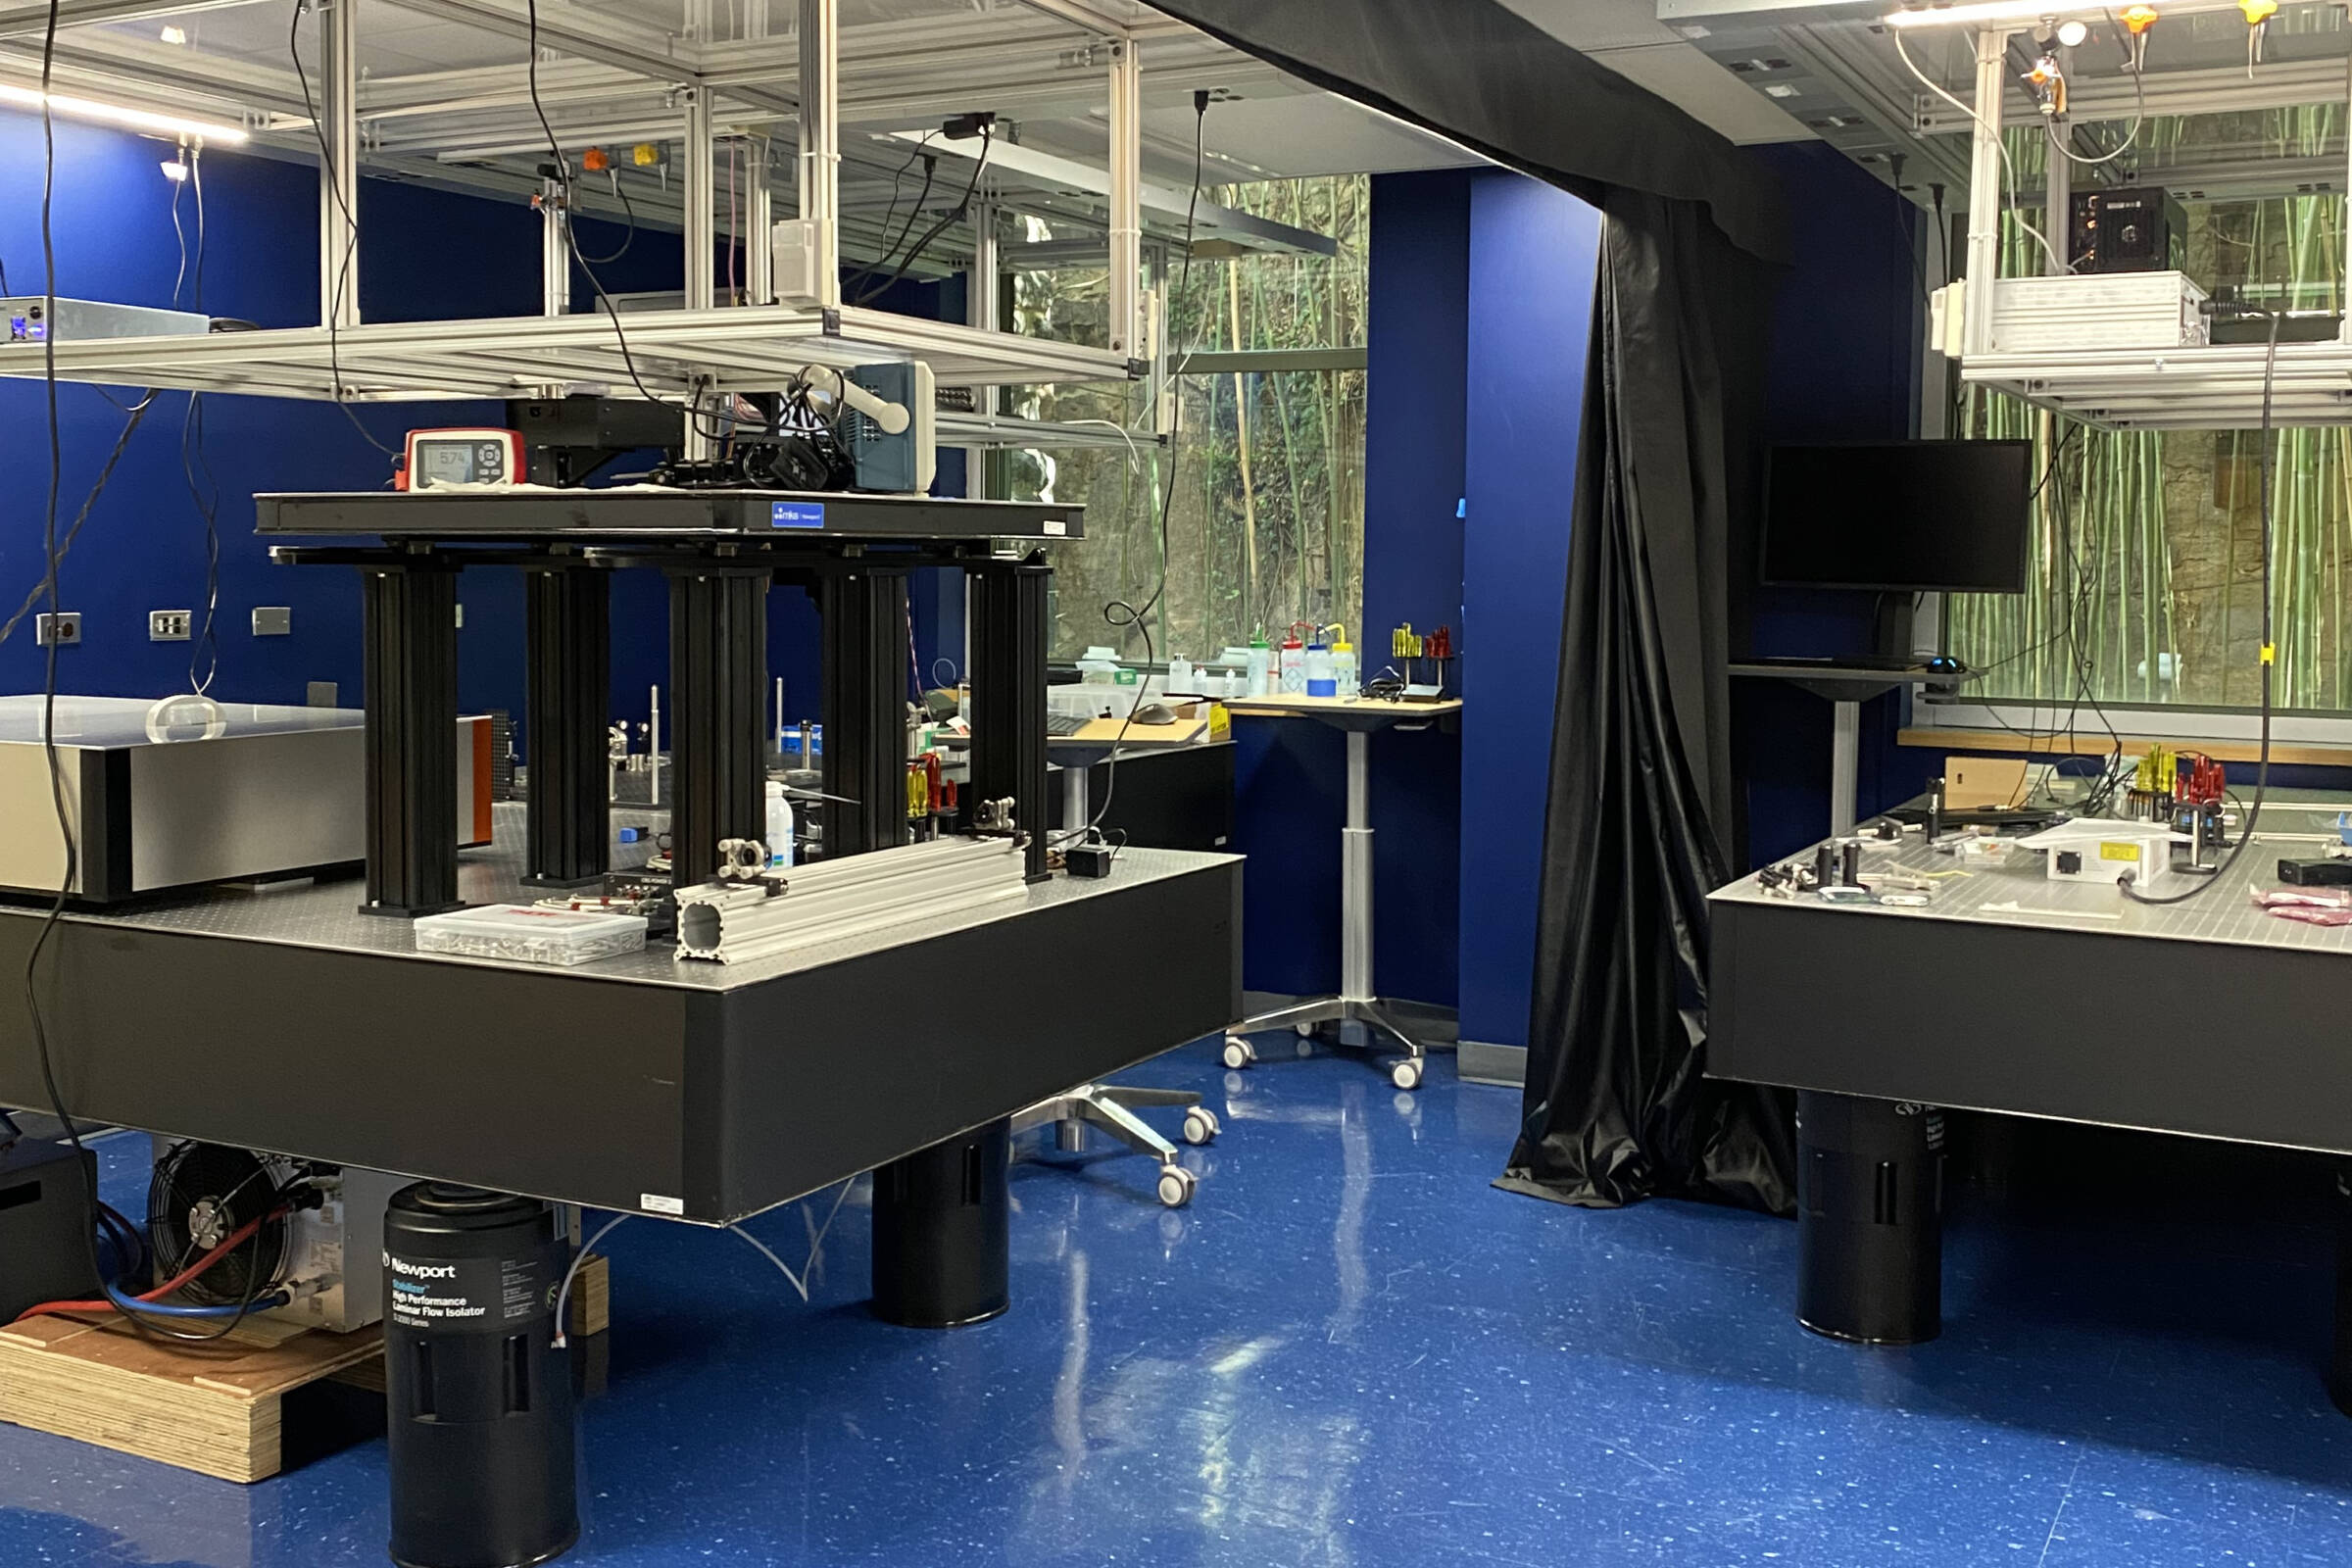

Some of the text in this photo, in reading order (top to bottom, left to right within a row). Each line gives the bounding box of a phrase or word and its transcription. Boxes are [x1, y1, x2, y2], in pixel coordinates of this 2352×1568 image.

[392, 1257, 456, 1280] Newport
[408, 1294, 466, 1306] Performance
[393, 1301, 486, 1317] Laminar Flow Isolator
